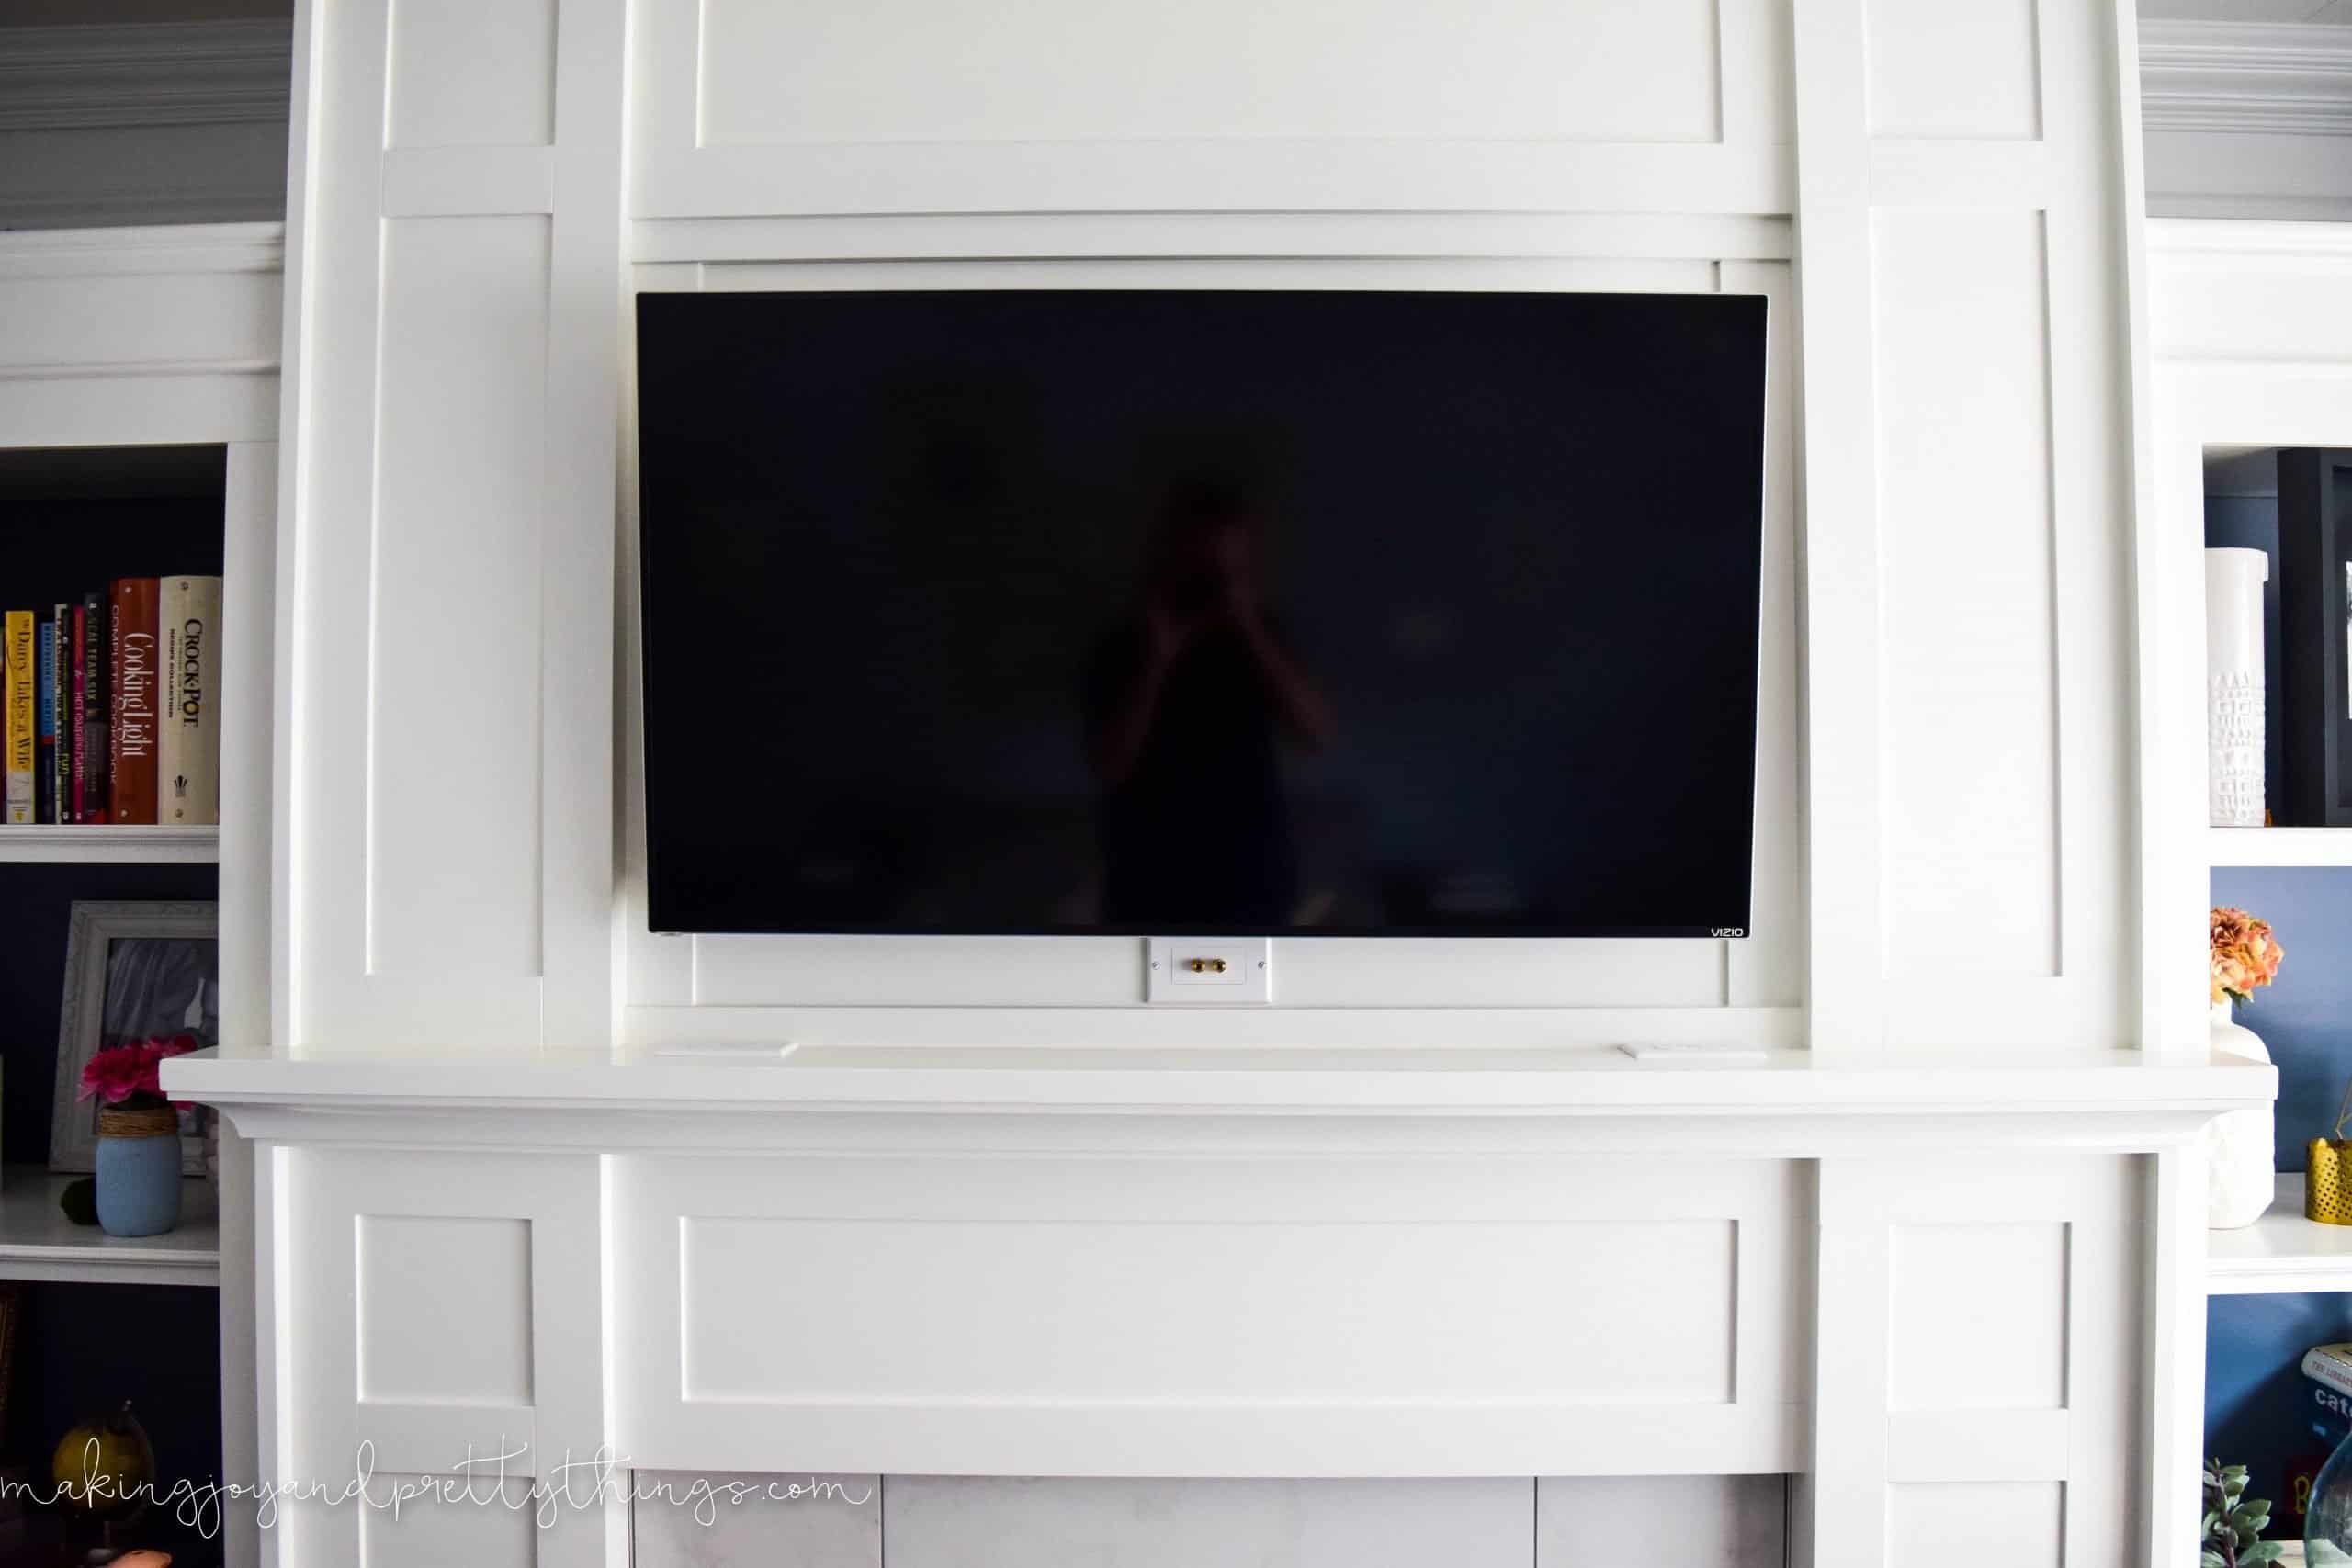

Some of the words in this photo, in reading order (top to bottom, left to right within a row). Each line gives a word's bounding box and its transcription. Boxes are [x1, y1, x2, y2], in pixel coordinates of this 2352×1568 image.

[119, 632, 154, 710] Cooking
[119, 712, 153, 756] Light
[1711, 928, 1744, 937] VIZIO
